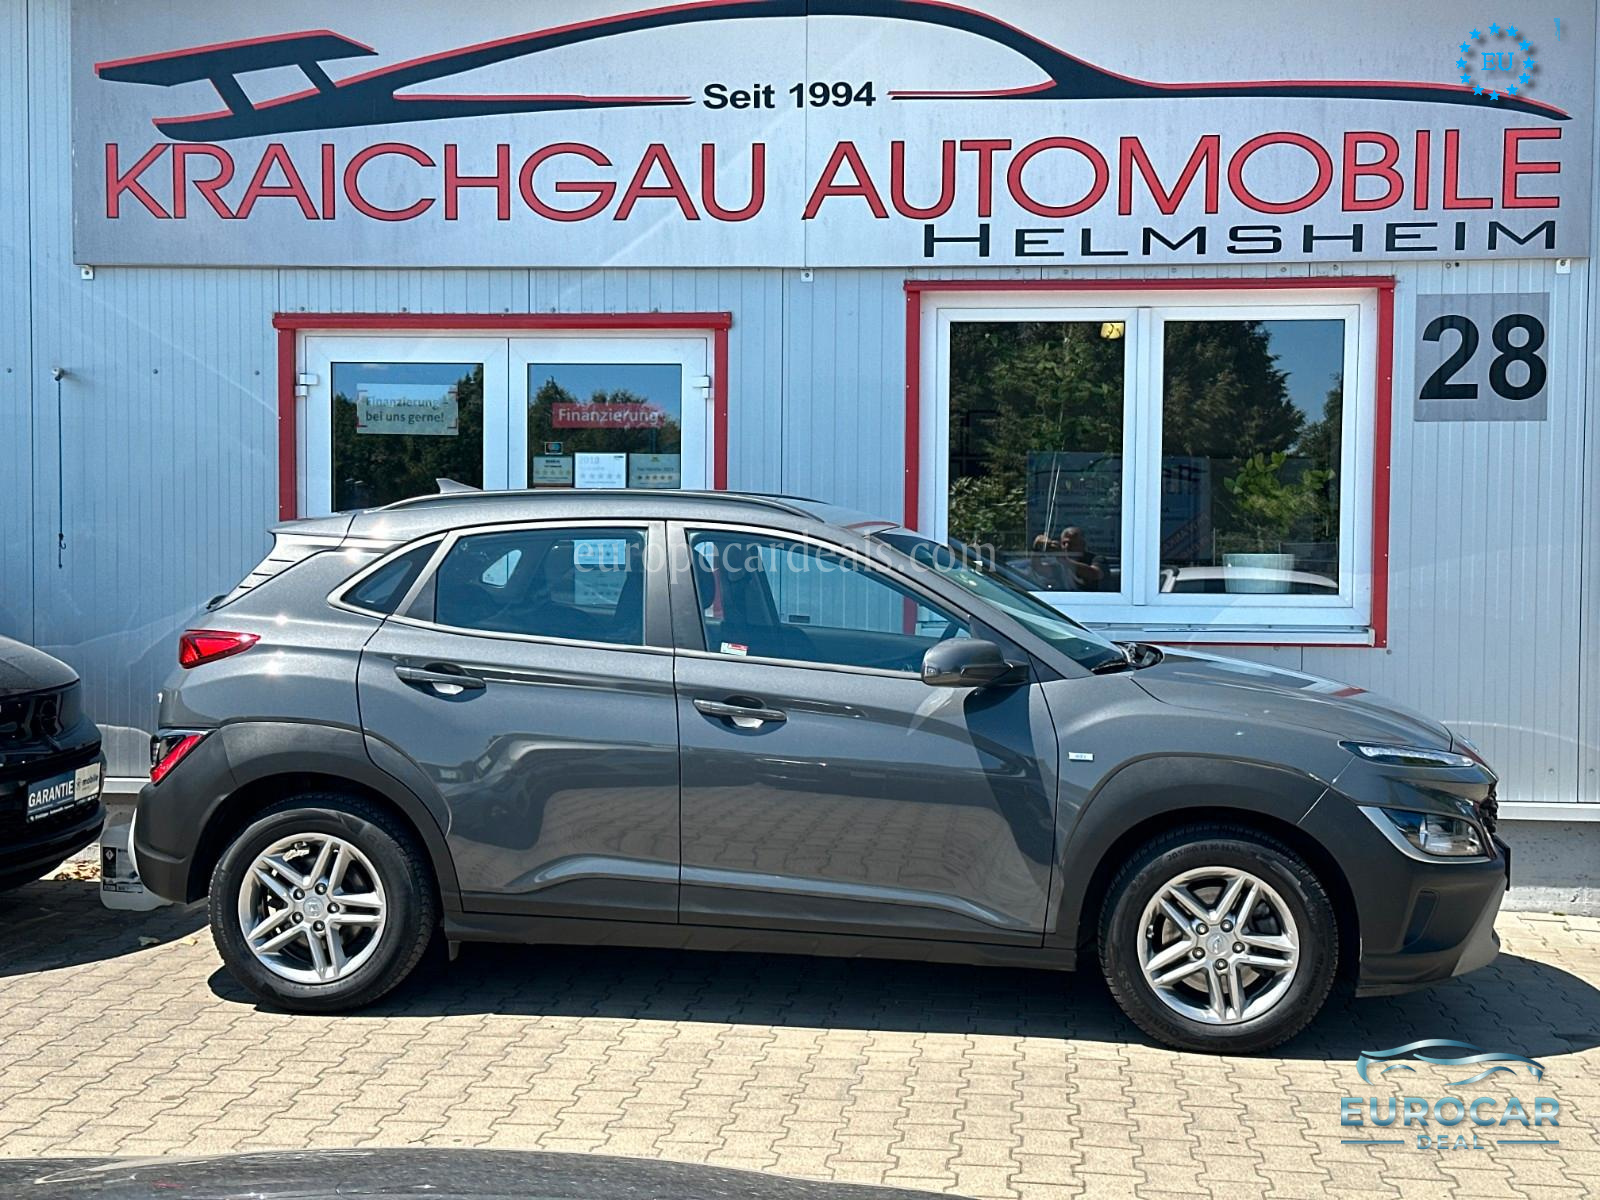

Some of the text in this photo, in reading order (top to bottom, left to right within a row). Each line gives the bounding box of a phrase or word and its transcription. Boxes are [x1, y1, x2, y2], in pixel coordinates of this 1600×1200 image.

[704, 81, 876, 109] Seit 1994
[106, 126, 1562, 222] KRAICHGAU AUTOMOBILE
[924, 220, 1556, 258] HELMSHEIM
[1419, 312, 1547, 401] 28
[366, 411, 444, 424] bei uns gerne!
[558, 408, 658, 424] Finanzierung
[28, 780, 74, 807] GARANTIE
